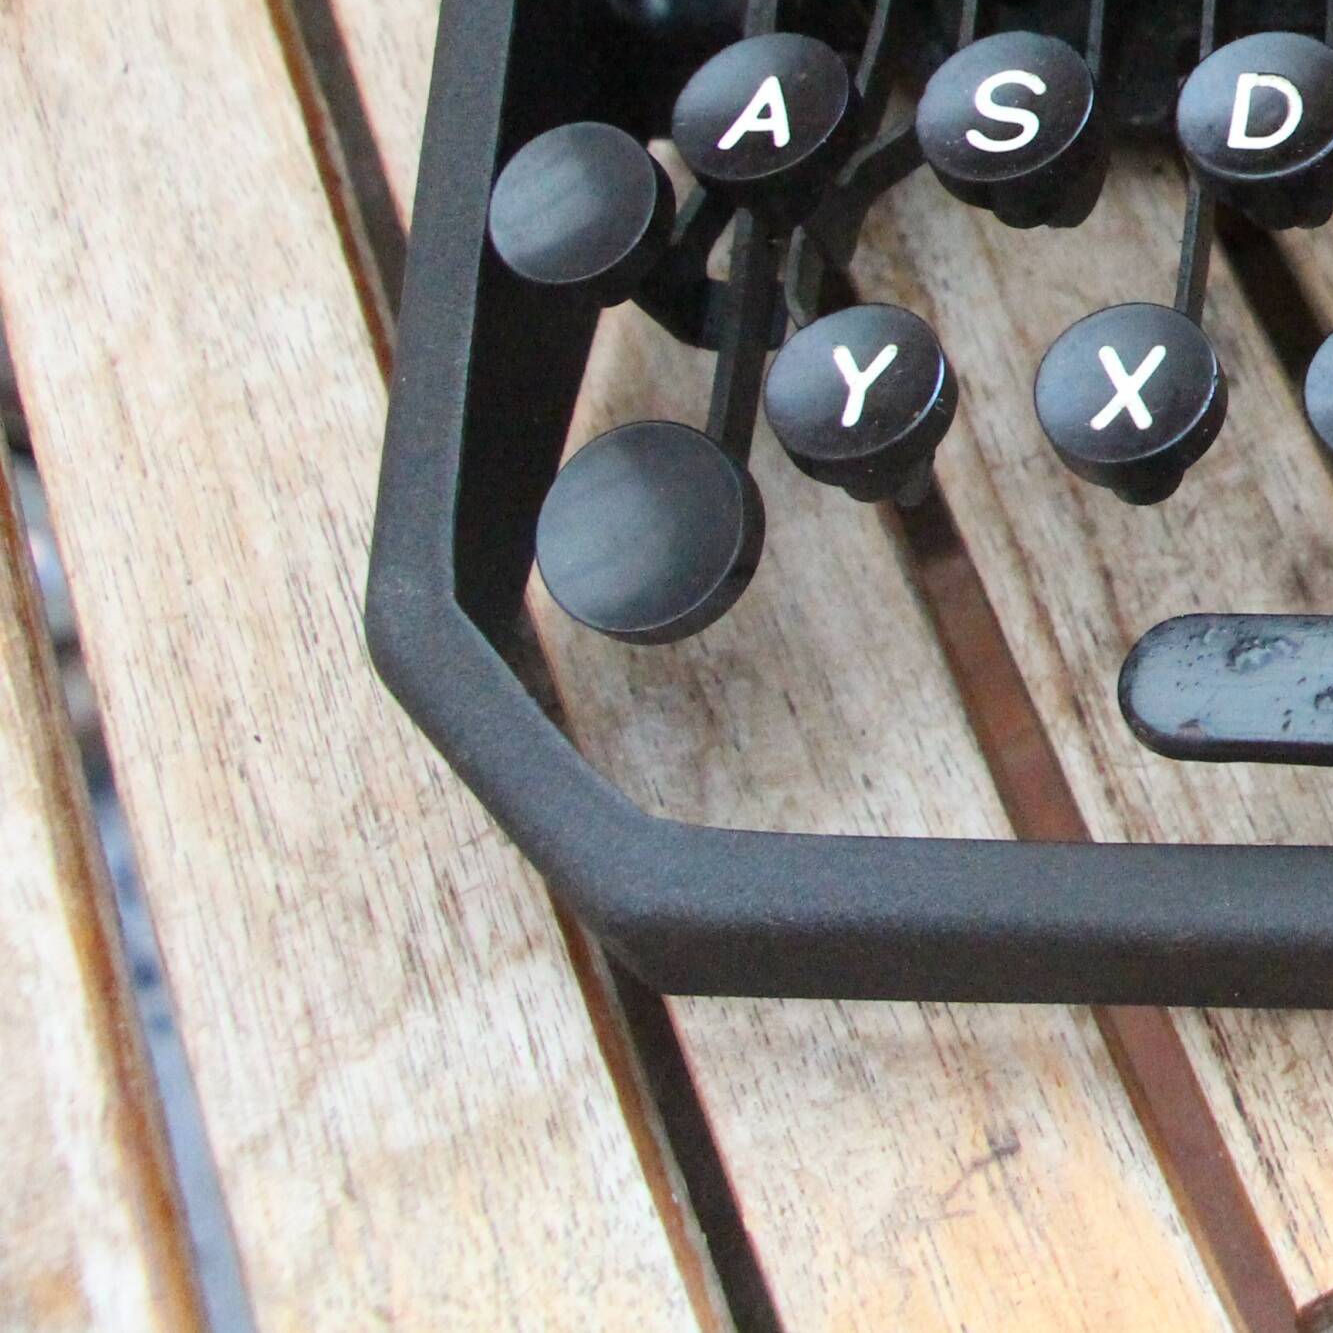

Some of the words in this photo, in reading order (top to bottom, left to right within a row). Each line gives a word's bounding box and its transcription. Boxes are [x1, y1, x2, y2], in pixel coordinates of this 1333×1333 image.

[717, 74, 792, 152] A
[965, 68, 1048, 154] S
[1226, 72, 1304, 150] D
[832, 342, 899, 428] Y
[1089, 343, 1168, 432] X
